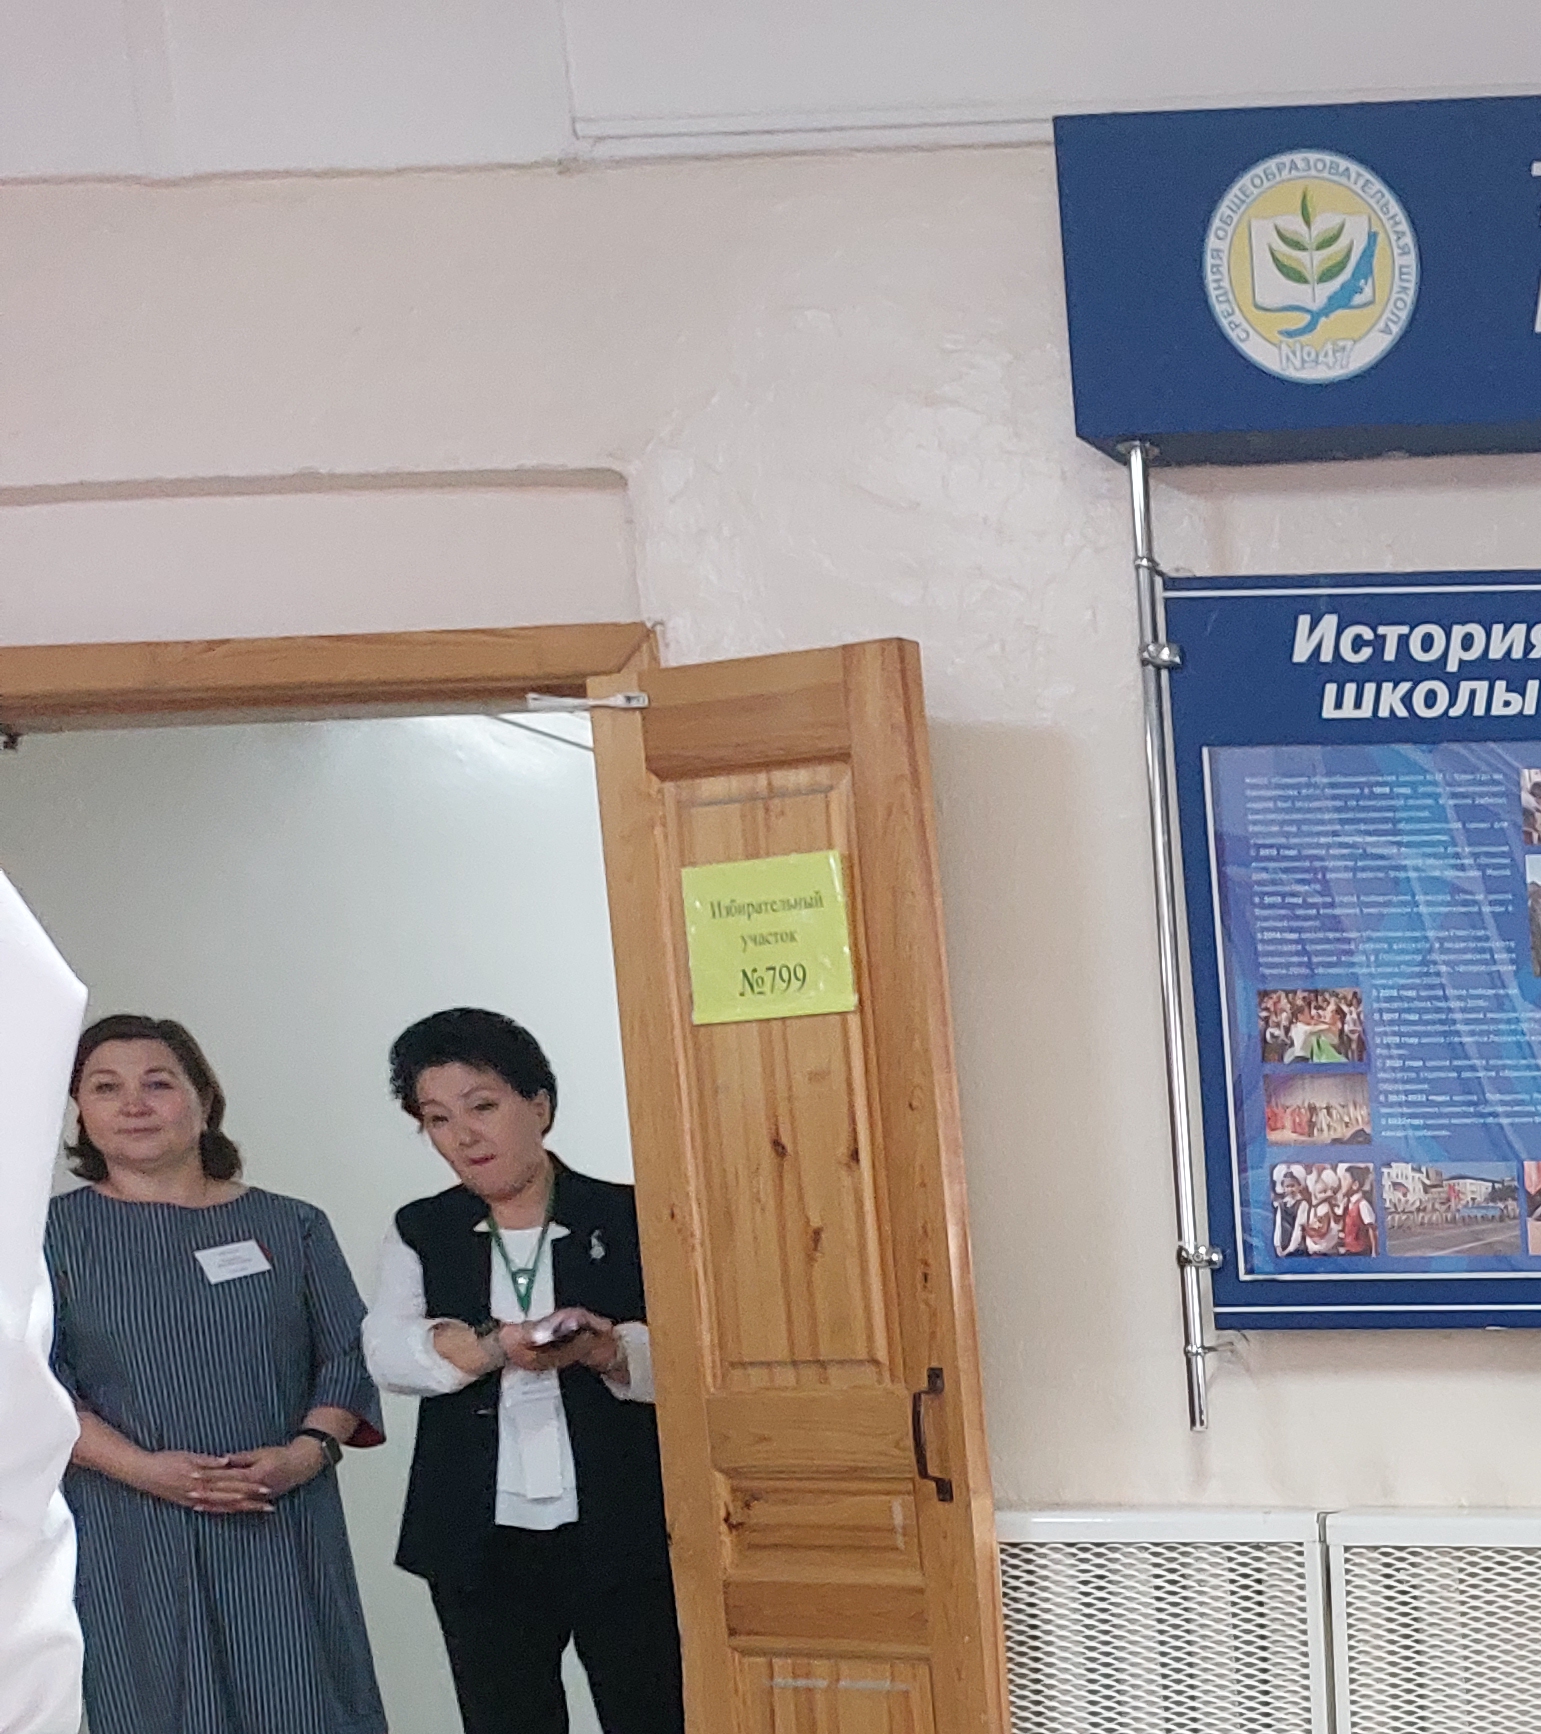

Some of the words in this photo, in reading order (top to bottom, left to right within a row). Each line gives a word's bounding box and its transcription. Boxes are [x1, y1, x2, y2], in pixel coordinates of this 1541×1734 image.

[1213, 156, 1412, 256] ОБЩЕОБРАЗОВАТЕЛЬНАЯ
[1209, 247, 1251, 343] СРЕДНЯЯ
[1378, 262, 1415, 337] ШКОЛА
[1277, 338, 1357, 372] №47
[1321, 678, 1541, 720] школы
[709, 890, 824, 920] Избирательный
[740, 930, 799, 953] участок
[738, 963, 807, 997] №799
